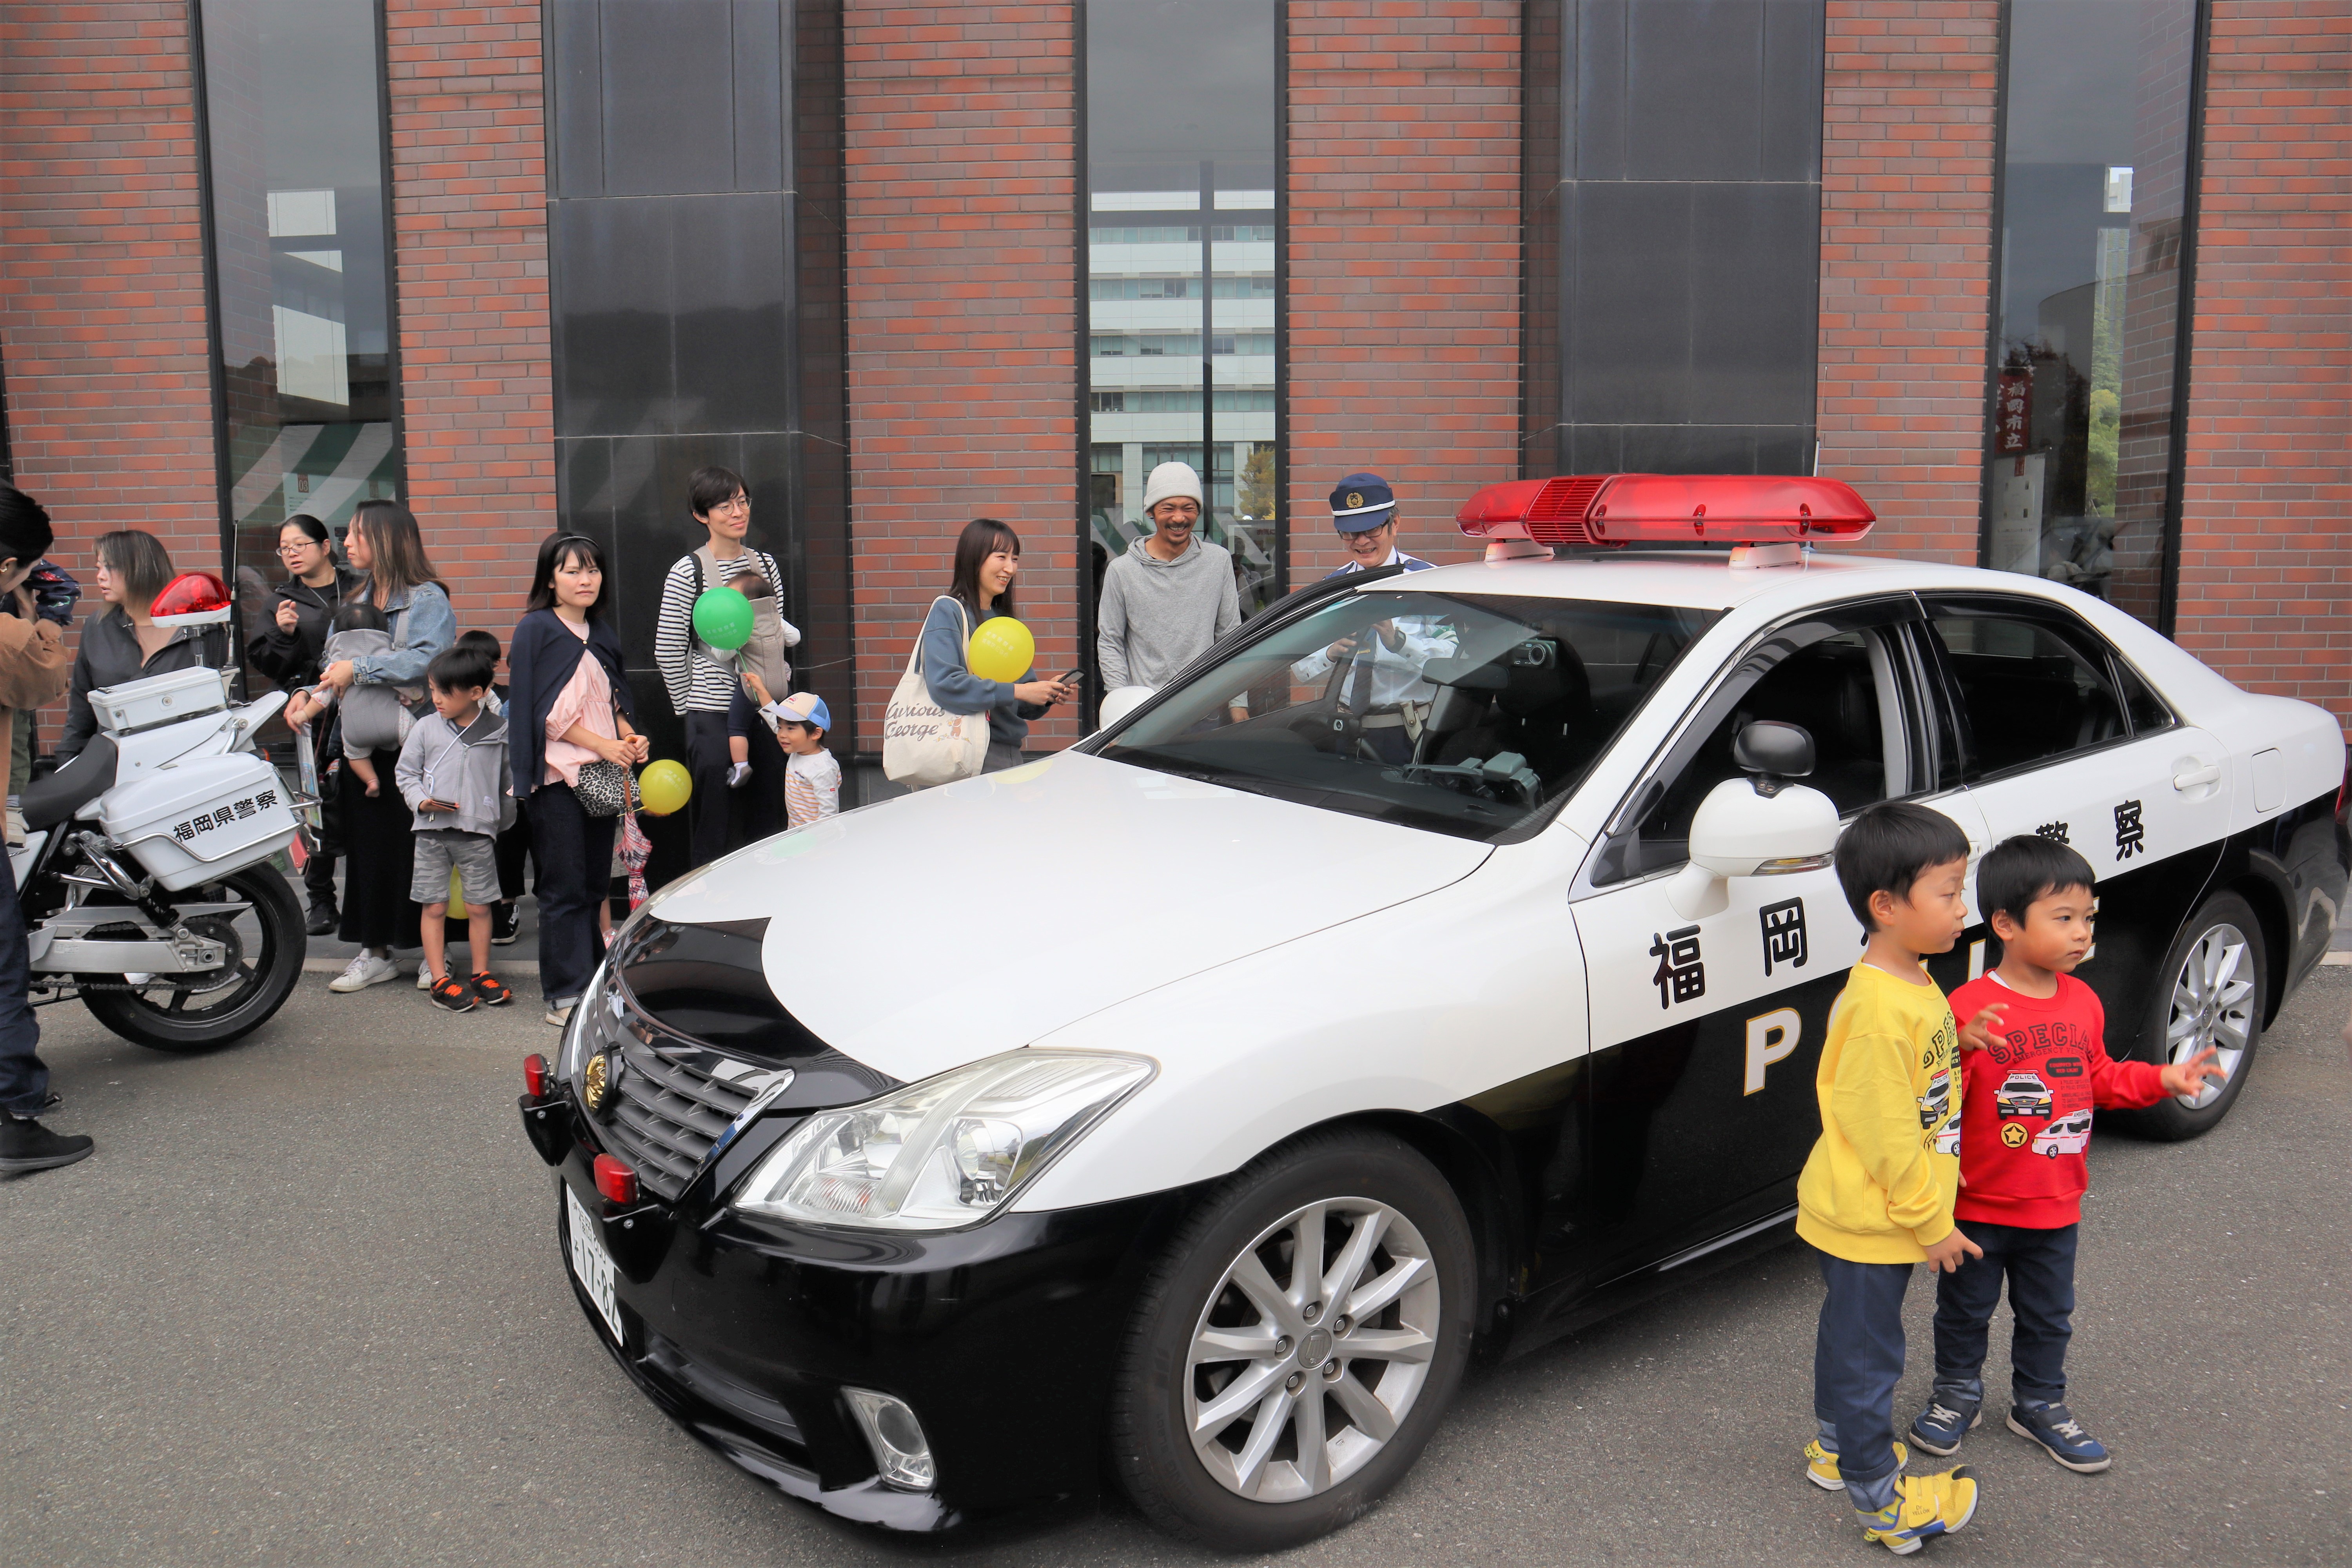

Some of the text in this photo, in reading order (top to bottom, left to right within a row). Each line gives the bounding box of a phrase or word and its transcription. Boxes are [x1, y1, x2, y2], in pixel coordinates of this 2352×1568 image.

[2005, 380, 2025, 449] 福岡市立
[299, 479, 308, 491] 03
[886, 701, 945, 720] Curious
[885, 720, 939, 742] George
[174, 789, 278, 842] 福岡県警察
[2013, 1047, 2063, 1063] EMERGENCY
[1933, 1074, 1948, 1085] POLICE
[581, 1236, 619, 1333] 17-82
